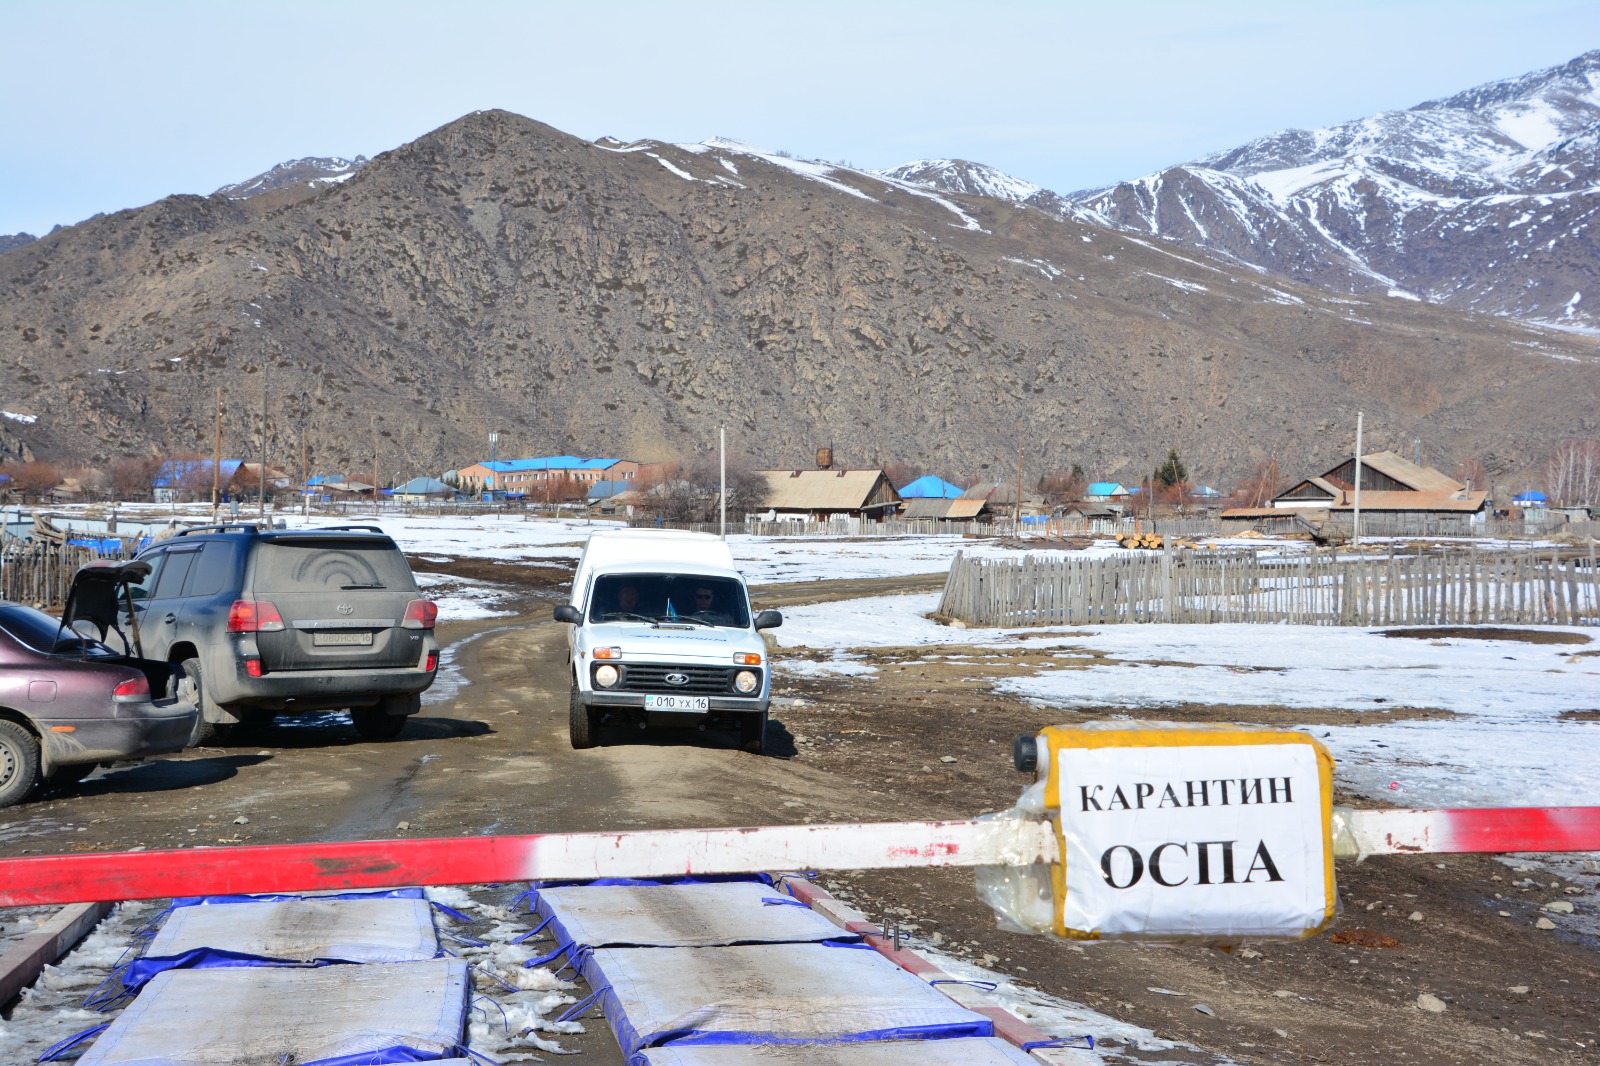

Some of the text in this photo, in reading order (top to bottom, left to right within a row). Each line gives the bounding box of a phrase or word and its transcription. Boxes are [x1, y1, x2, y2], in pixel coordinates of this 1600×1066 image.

[656, 696, 675, 707] 010
[679, 699, 691, 708] YX
[695, 698, 707, 709] 16
[1079, 777, 1293, 812] КАРАНТИН
[1100, 839, 1285, 889] ОСПА
